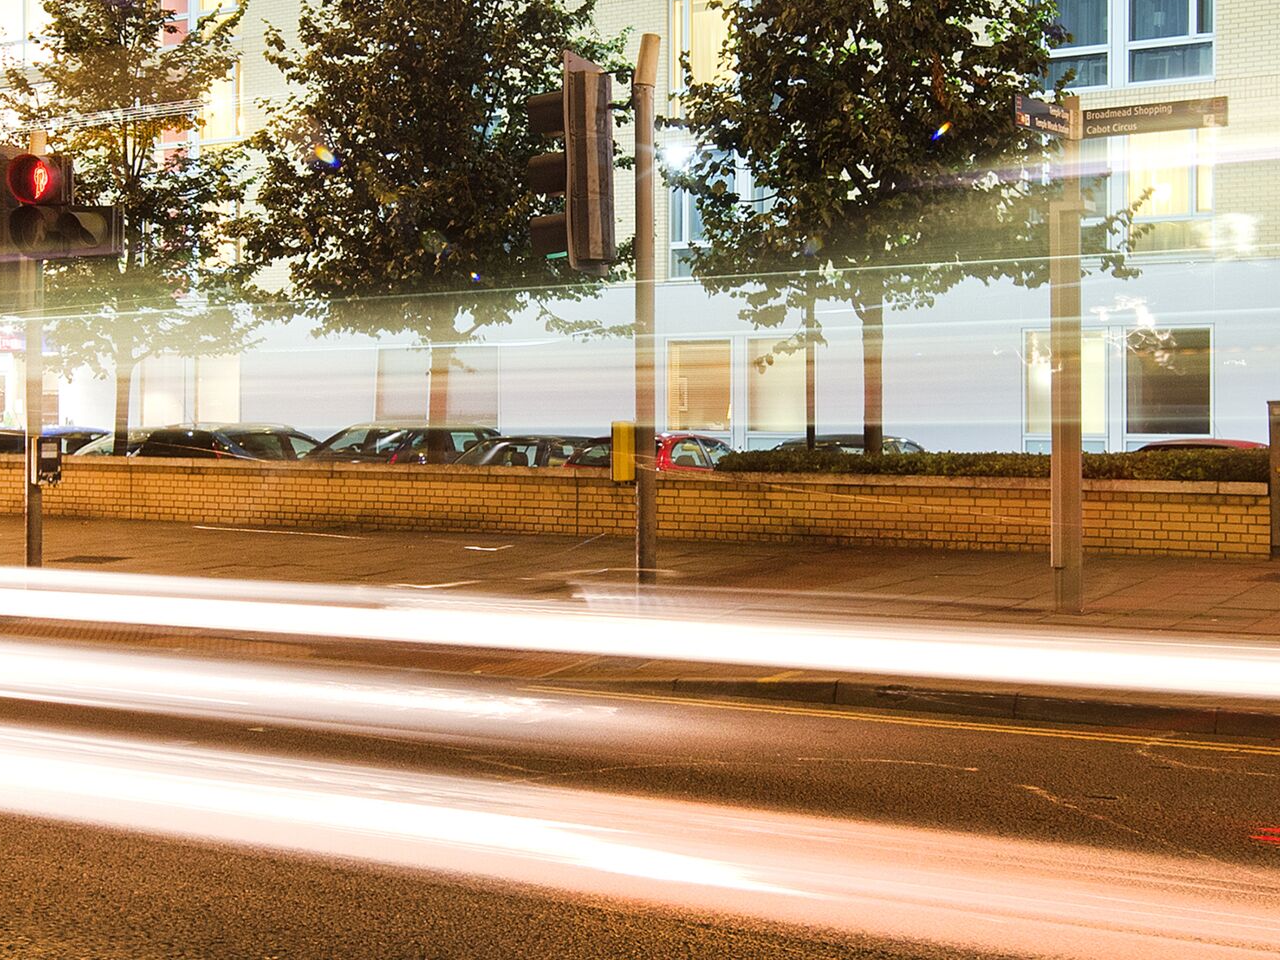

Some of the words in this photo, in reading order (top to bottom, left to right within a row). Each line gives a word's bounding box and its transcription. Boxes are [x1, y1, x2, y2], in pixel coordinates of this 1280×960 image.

[1086, 106, 1131, 120] Broadmead
[1134, 104, 1173, 115] Shopping
[1086, 124, 1110, 135] Cabot
[1112, 123, 1137, 132] Circus
